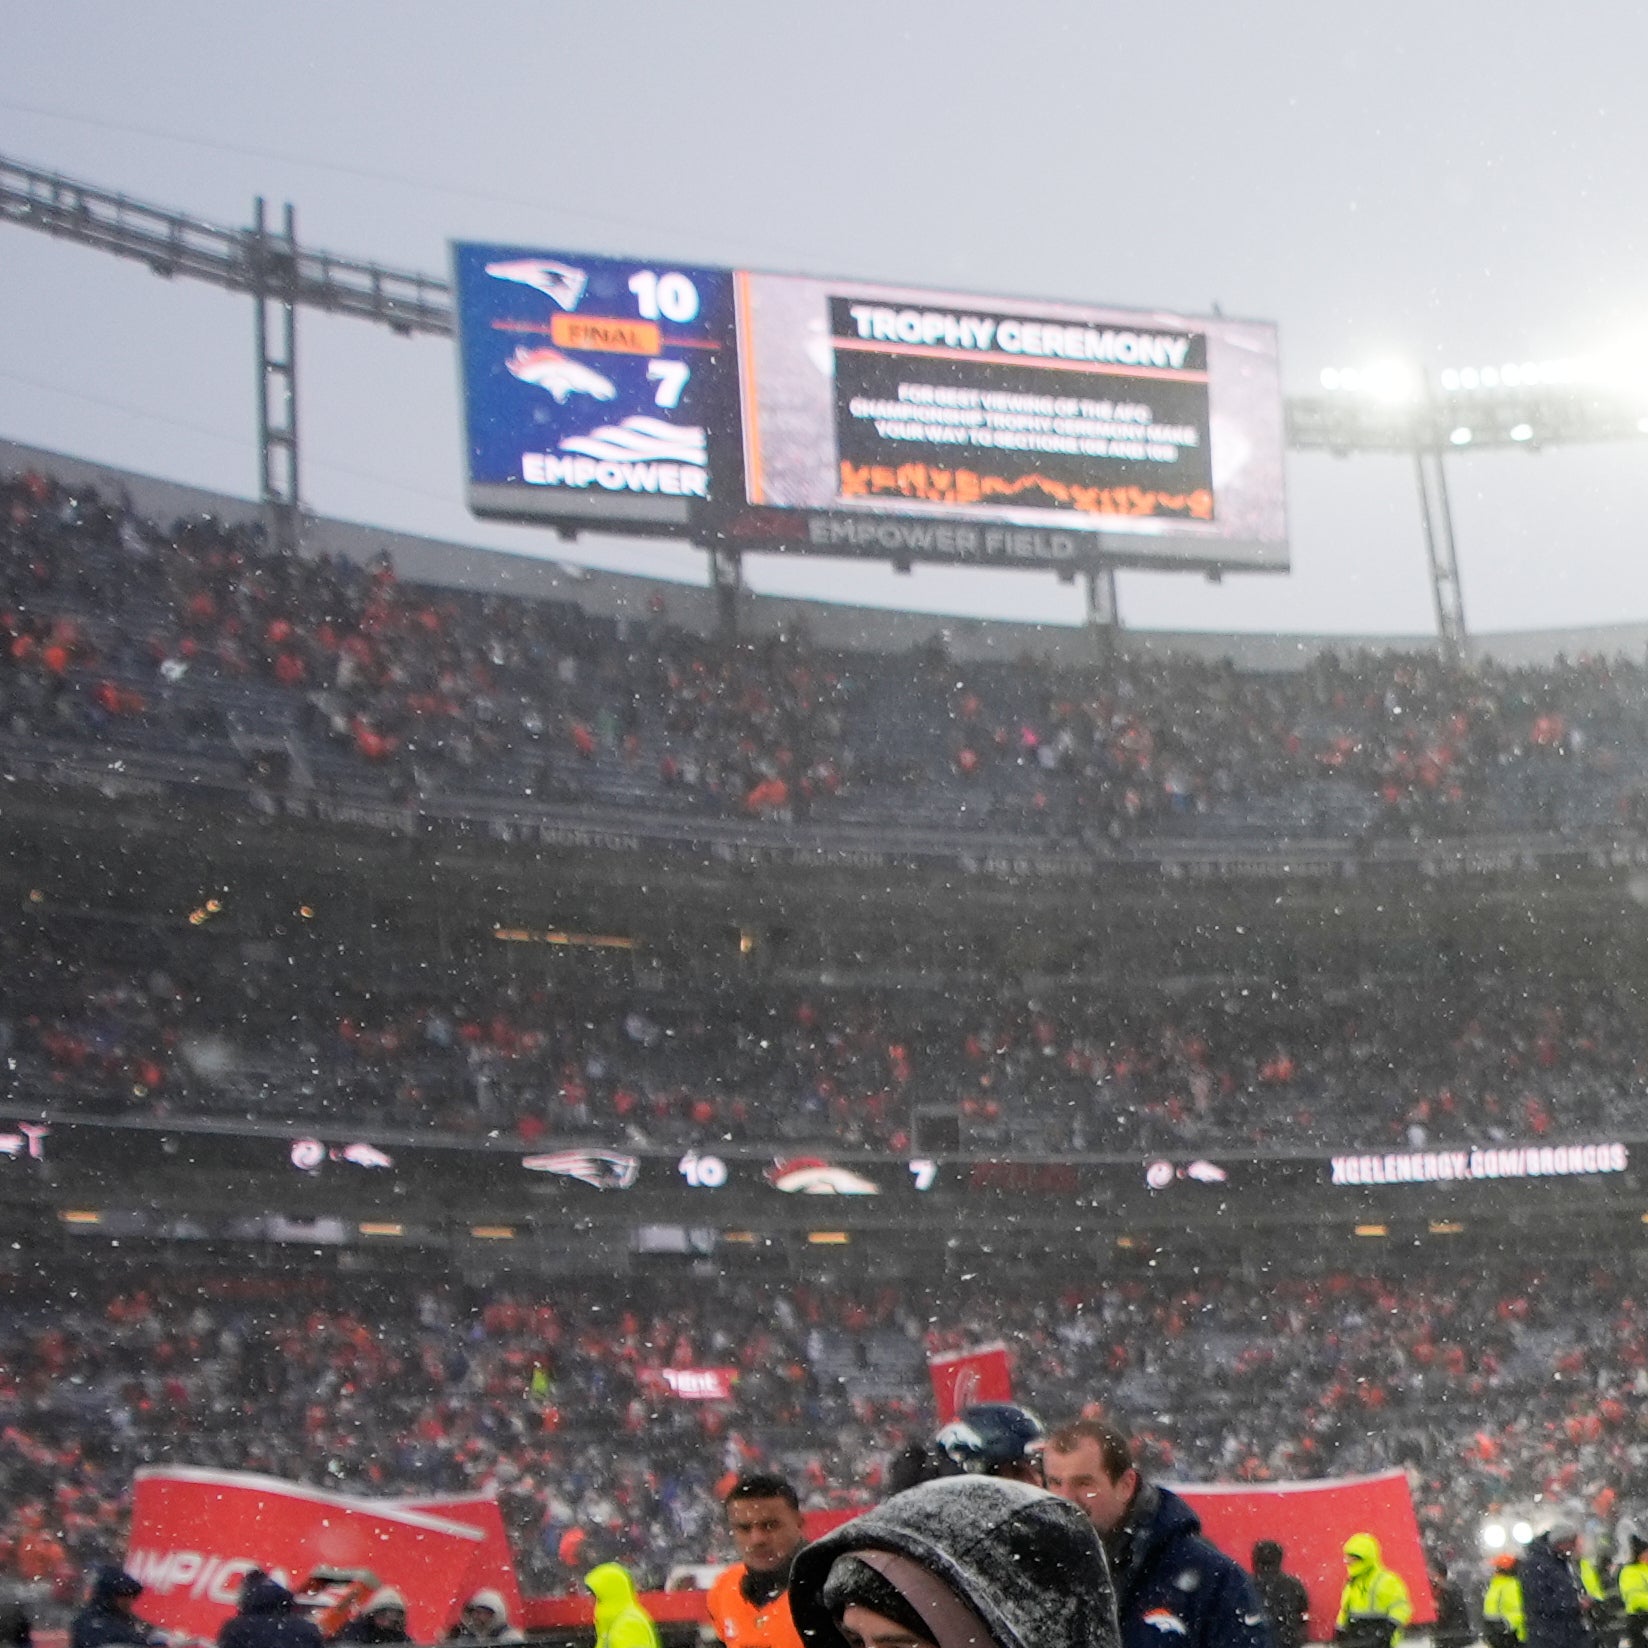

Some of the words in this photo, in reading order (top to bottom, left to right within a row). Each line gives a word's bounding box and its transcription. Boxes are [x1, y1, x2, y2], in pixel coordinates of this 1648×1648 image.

[628, 270, 699, 322] 10
[569, 324, 639, 346] FINAL
[850, 304, 996, 350] TROPHY
[996, 320, 1189, 368] CEREMONY
[646, 358, 690, 408] 7
[522, 452, 708, 496] EMPOWER
[808, 514, 976, 552] EMPOWER
[984, 527, 1073, 558] FIELD
[679, 1149, 726, 1186] 10
[909, 1159, 936, 1189] 7
